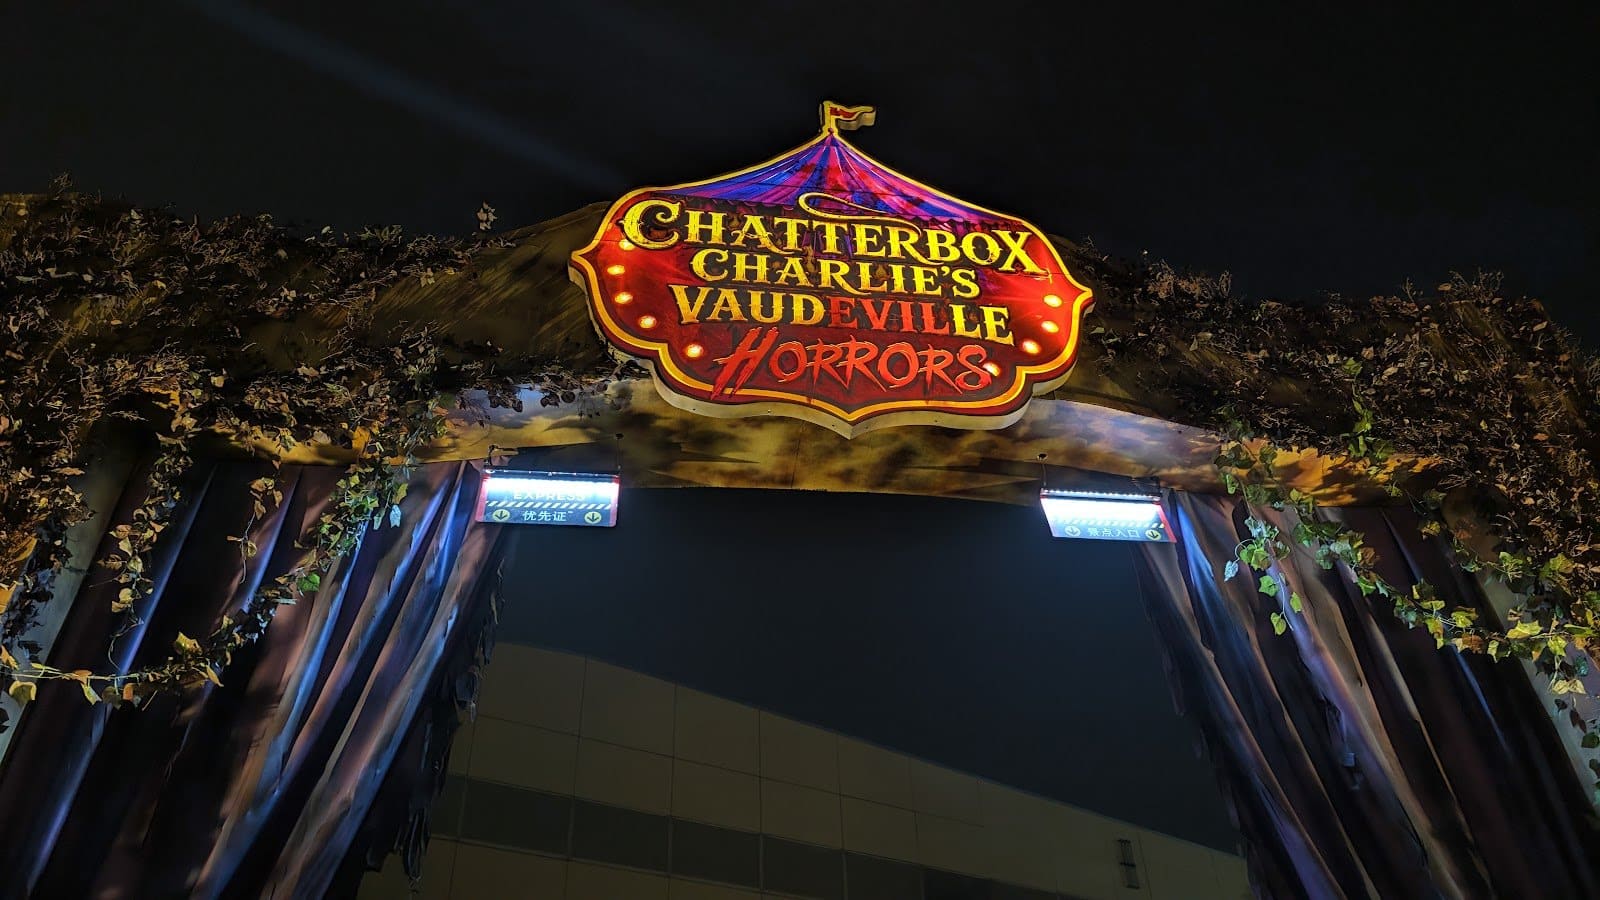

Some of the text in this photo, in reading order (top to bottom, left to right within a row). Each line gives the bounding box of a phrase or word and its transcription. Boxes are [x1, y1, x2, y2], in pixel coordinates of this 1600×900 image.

[622, 195, 1052, 276] CHATTERBOX
[692, 249, 980, 298] CHARLIE'S
[668, 284, 1015, 346] VAUDEVILLE
[711, 326, 999, 399] HORRORS
[513, 489, 586, 501] EXPRESS
[522, 510, 568, 522] 优先证
